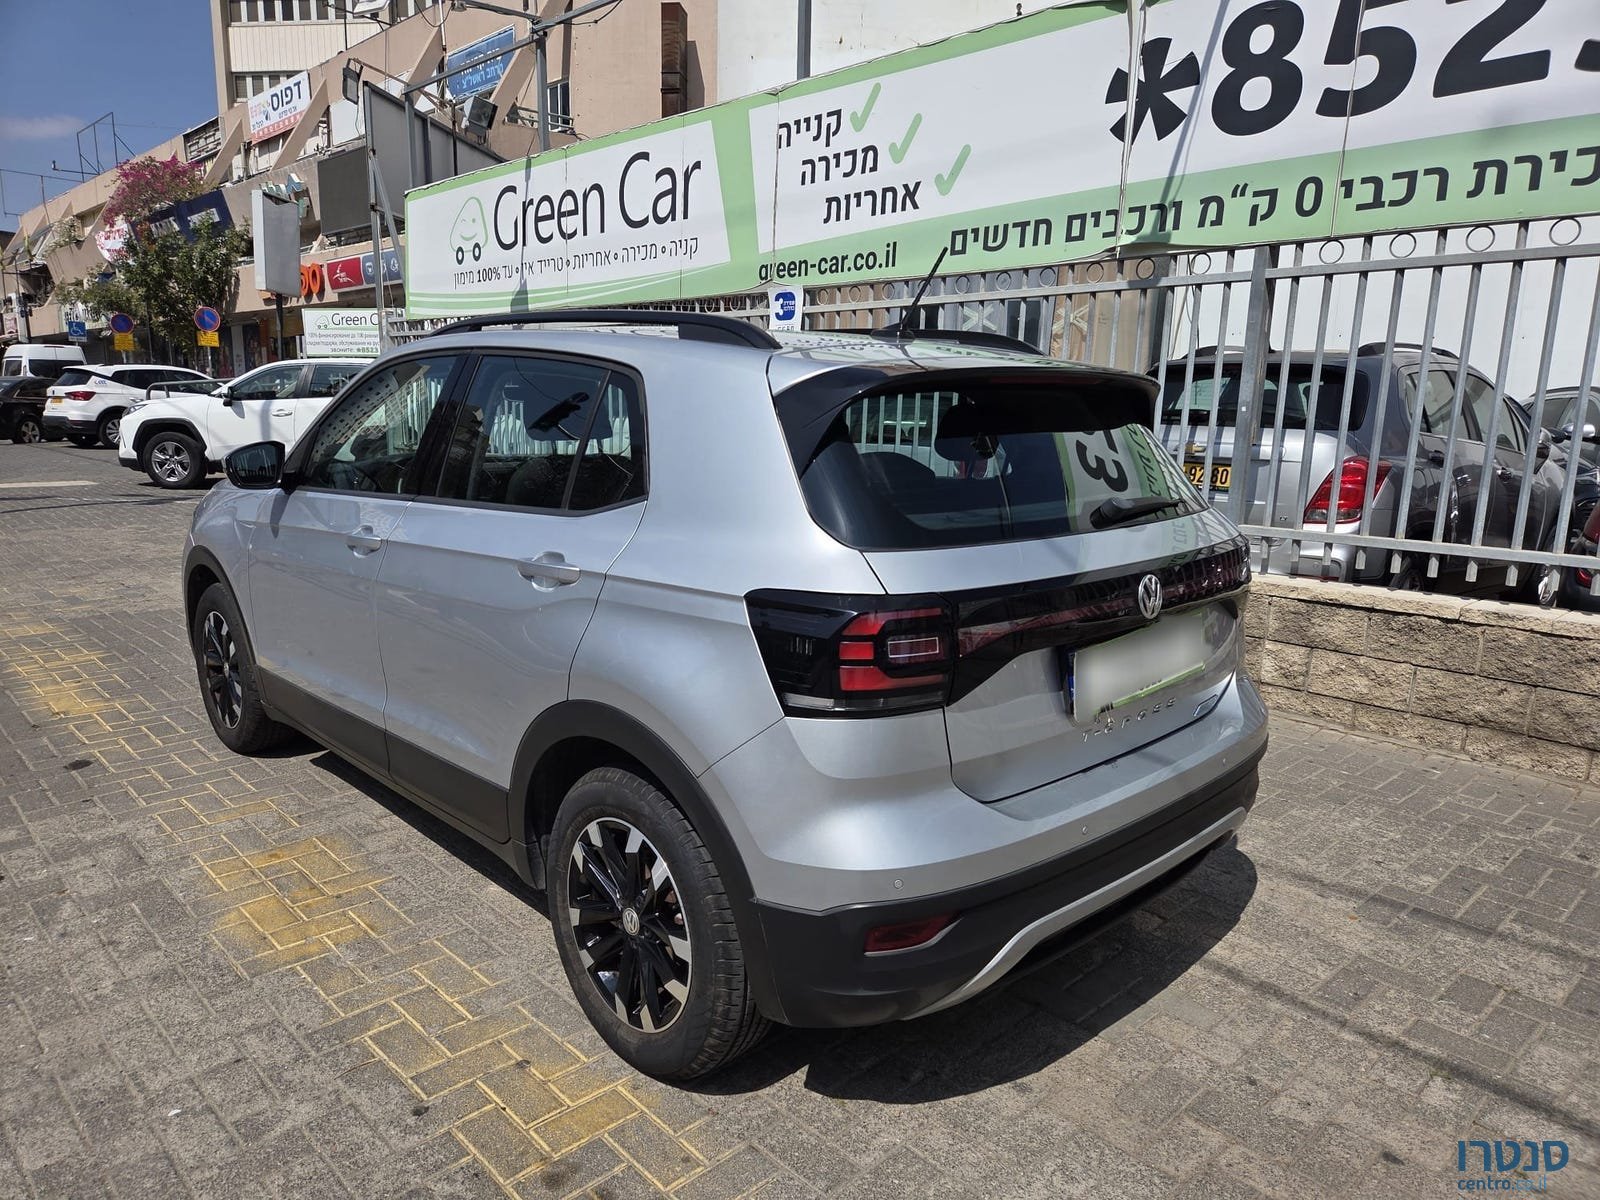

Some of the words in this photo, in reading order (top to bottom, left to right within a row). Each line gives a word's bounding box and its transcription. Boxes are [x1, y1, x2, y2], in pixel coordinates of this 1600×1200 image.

[271, 81, 302, 111] דפוס
[778, 109, 842, 149] קנייה
[800, 144, 879, 186] מכירה
[494, 184, 605, 250] Green
[618, 151, 702, 229] Car
[823, 180, 922, 224] אחריות
[1295, 175, 1324, 217] 0
[1339, 167, 1449, 211] רכבי
[950, 219, 1052, 256] חדשים
[1065, 200, 1183, 243] ורכבים
[537, 256, 564, 272] טרייד
[572, 249, 611, 270] אחריות
[622, 243, 657, 263] מכירה
[669, 237, 698, 259] קניה
[758, 241, 897, 281] green-car.co.il
[454, 270, 475, 289] מימון
[477, 266, 501, 283] 100%
[502, 265, 513, 278] עד
[331, 313, 367, 326] Green
